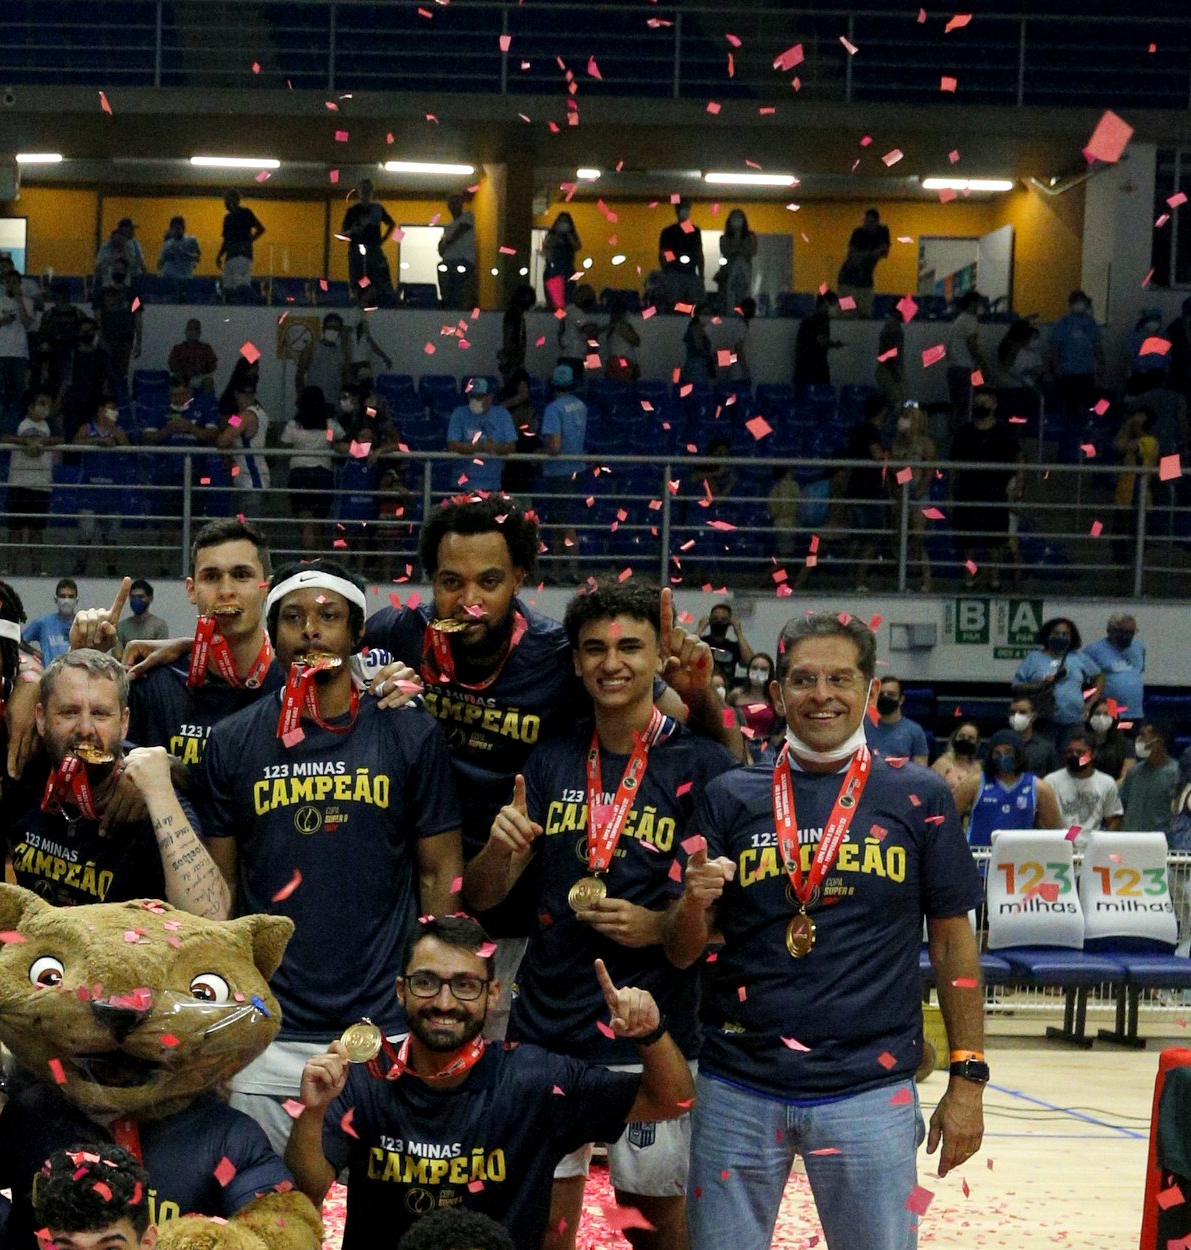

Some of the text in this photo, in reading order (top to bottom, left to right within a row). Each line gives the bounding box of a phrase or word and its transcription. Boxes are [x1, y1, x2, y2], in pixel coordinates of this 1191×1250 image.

[960, 600, 985, 631] B
[1011, 602, 1039, 632] A
[426, 683, 442, 694] 23
[180, 724, 203, 738] 123
[425, 692, 540, 745] AMPEÃO
[263, 761, 346, 779] 123 MINAS
[254, 768, 390, 816] CAMPEÃO
[562, 789, 584, 802] 123
[545, 801, 676, 852] CAEÃO
[797, 828, 850, 843] INS
[25, 832, 79, 862] 123 MINAS
[14, 842, 114, 902] CAMPEÃO
[740, 837, 906, 888] CAEÃO
[997, 861, 1072, 895] 123
[1093, 866, 1168, 896] 123
[999, 898, 1077, 914] milhas
[1096, 900, 1174, 913] milhas
[380, 1135, 461, 1159] 123 MINAS
[368, 1147, 506, 1184] CAMPEÃO
